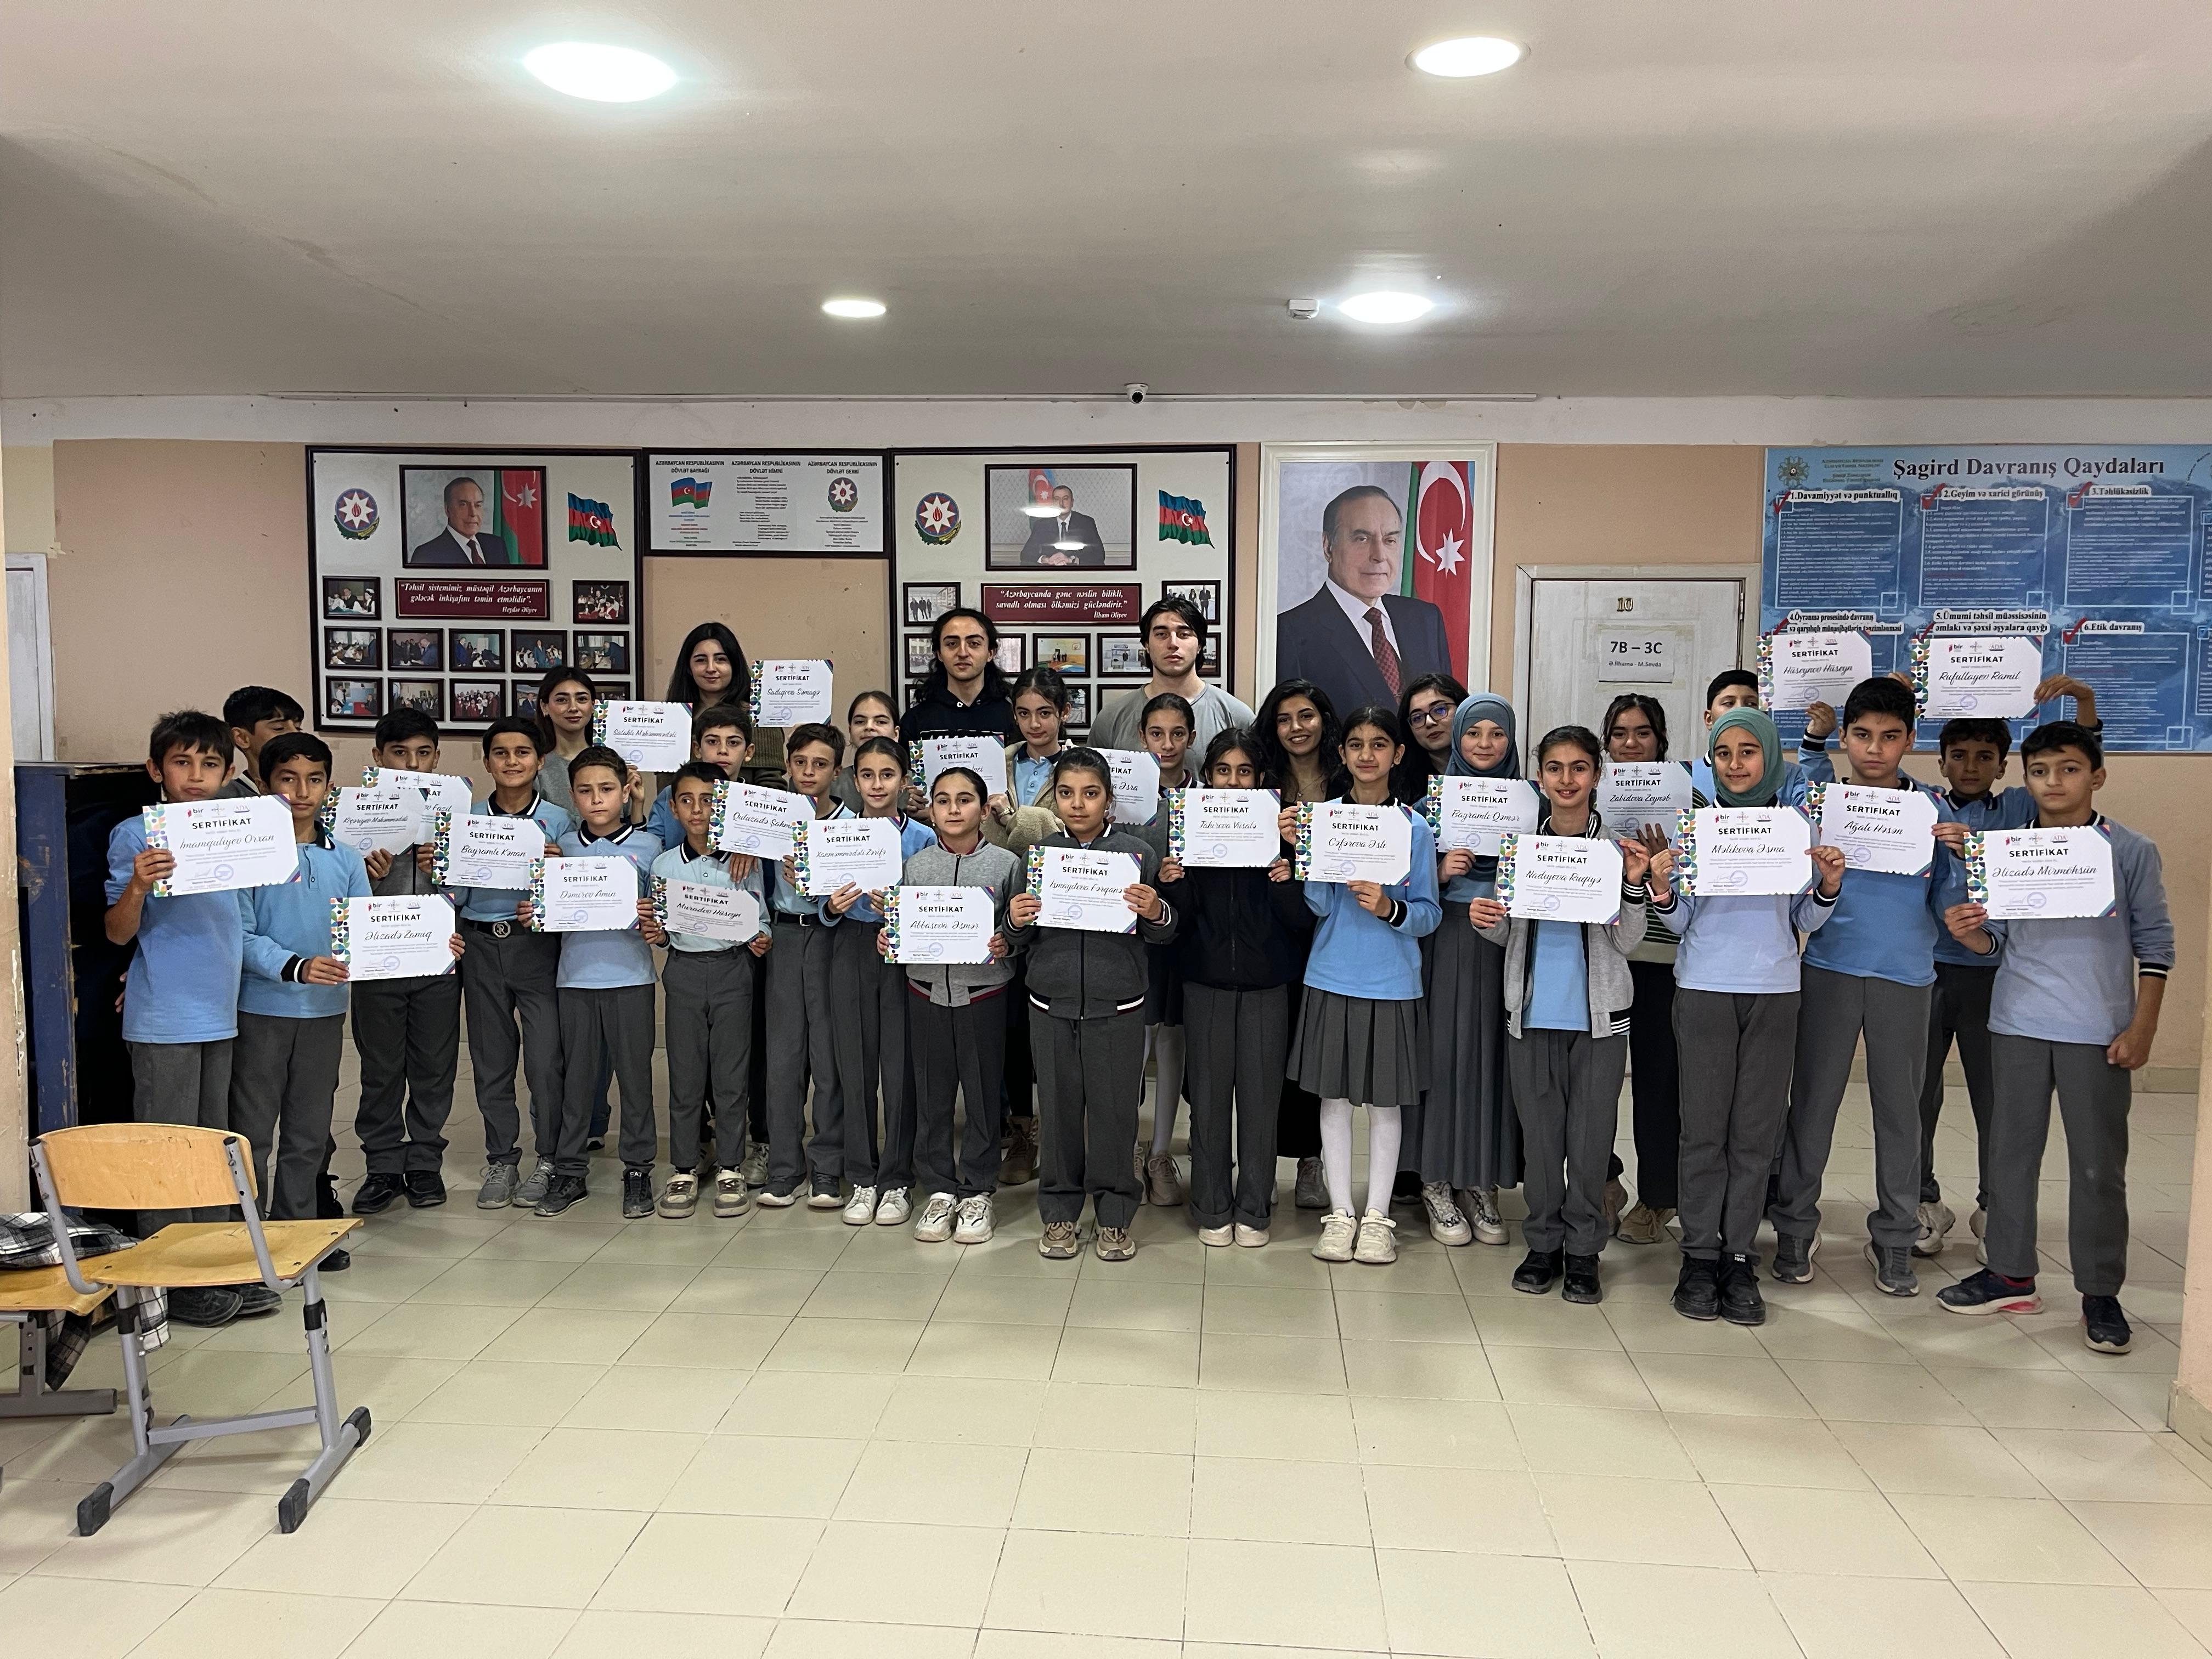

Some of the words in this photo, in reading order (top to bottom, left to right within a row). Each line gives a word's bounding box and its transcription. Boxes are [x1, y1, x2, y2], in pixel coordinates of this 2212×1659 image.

[1893, 459, 1959, 479] Şagird
[1966, 458, 2057, 478] Davranış
[2063, 457, 2164, 478] Qaydaları
[1791, 492, 1842, 501] 1.Davamiyyət
[1854, 490, 1898, 501] punktuallıq
[1944, 490, 1976, 499] 2.Geyim
[2012, 490, 2043, 499] görünüş
[428, 584, 462, 592] sistemimiz
[466, 584, 494, 595] müstəqil
[497, 585, 543, 595] Azərbaycanın
[1102, 590, 1124, 599] bilikli,
[410, 594, 435, 603] gələcək
[996, 600, 1020, 608] savadlı
[1024, 600, 1047, 608] olması
[1051, 600, 1080, 608] ölkəmizi
[1617, 597, 1634, 612] 10
[1936, 611, 1971, 620] 5.Ümumi
[1973, 623, 1991, 633] şəxsi
[1993, 623, 2024, 633] əşyalara
[2027, 624, 2048, 633] qayğı
[1610, 641, 1628, 653] 7B
[1644, 642, 1662, 654] 3C
[1791, 649, 1838, 658] SERTİFİKAT
[1461, 795, 1508, 804] SERTİFİKAT
[744, 800, 788, 813] SERTİFİKAT
[1846, 805, 1901, 816] SERTİFİKAT
[1451, 809, 1490, 822] Bayramlı
[192, 817, 252, 830] SERTİFİKAT
[1331, 822, 1380, 831] SERTİFİKAT
[1844, 821, 1871, 835] Ağalı
[1873, 823, 1904, 836] Həsən
[1718, 827, 1773, 835] SERTİFİKAT
[245, 834, 274, 843] Orxan
[469, 832, 515, 841] SERTİFİKAT
[826, 834, 871, 843] SERTİFİKAT
[1328, 837, 1365, 851] Cəfərova
[1711, 844, 1754, 855] Məlikova
[1756, 843, 1786, 854] Əsma
[461, 845, 499, 857] Bayramlı
[500, 848, 526, 857] Kənan
[2009, 848, 2069, 858] SERTİFİKAT
[1537, 855, 1588, 864] SERTİFİKAT
[1062, 866, 1109, 876] SERTİFİKAT
[1991, 866, 2034, 878] Əlizadə
[684, 894, 729, 906] SERTİFİKAT
[370, 914, 421, 922] SERTİFİKAT
[365, 930, 402, 941] Əlizadə
